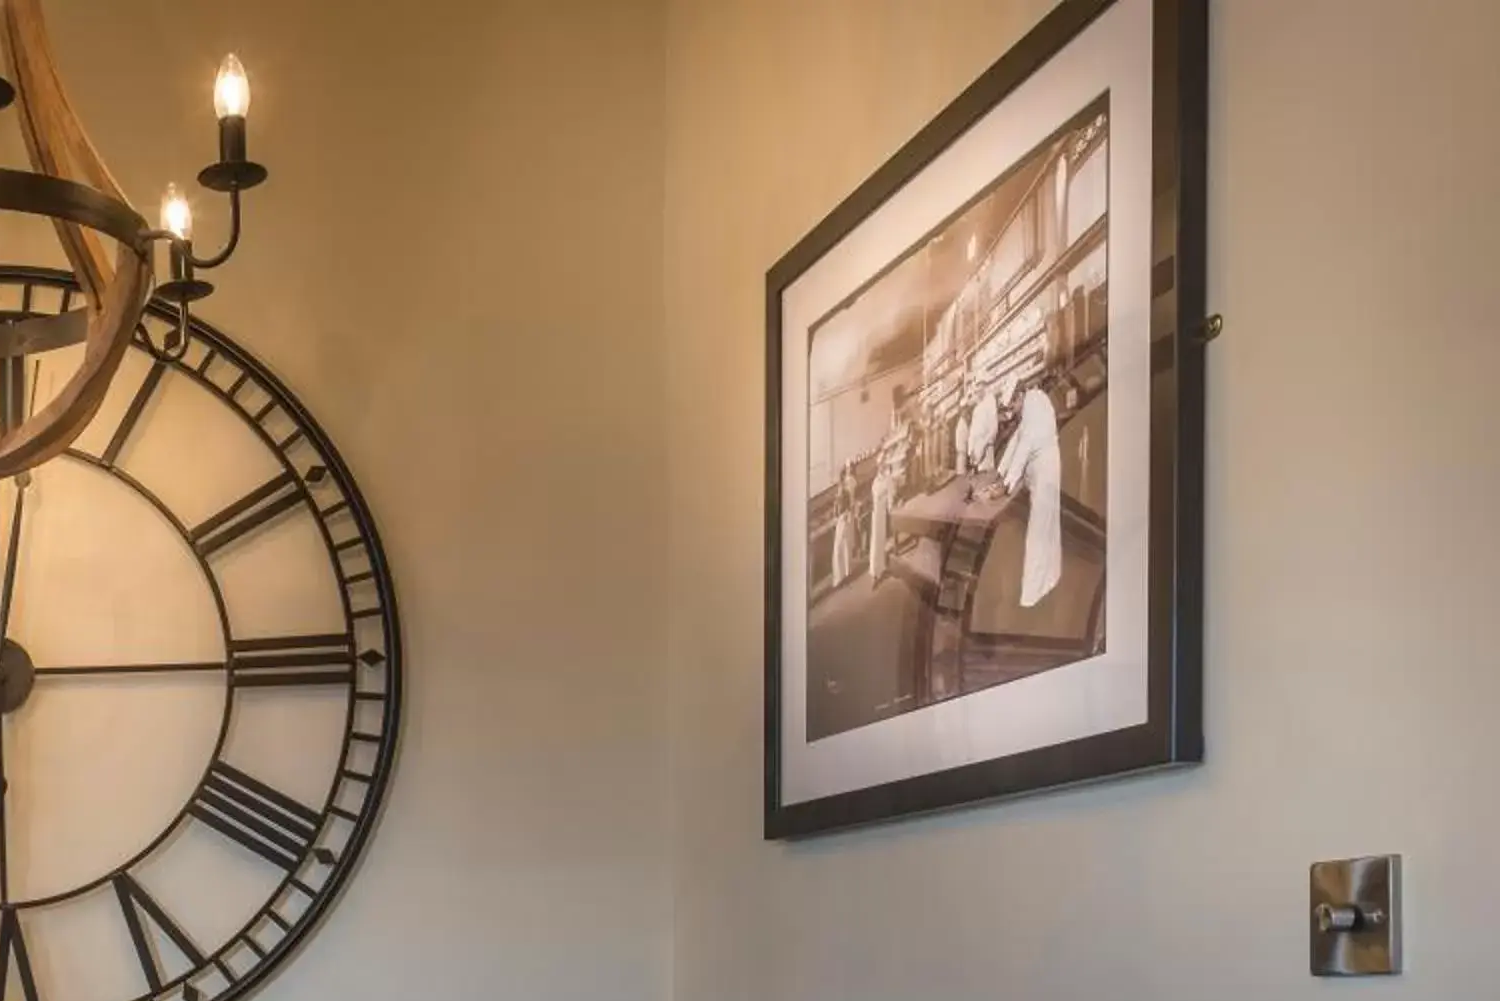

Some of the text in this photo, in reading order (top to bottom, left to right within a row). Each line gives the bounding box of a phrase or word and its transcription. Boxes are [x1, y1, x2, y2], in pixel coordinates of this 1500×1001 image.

[188, 469, 307, 558] II
[227, 633, 354, 688] III
[186, 760, 324, 876] IIII
[111, 868, 209, 996] V
